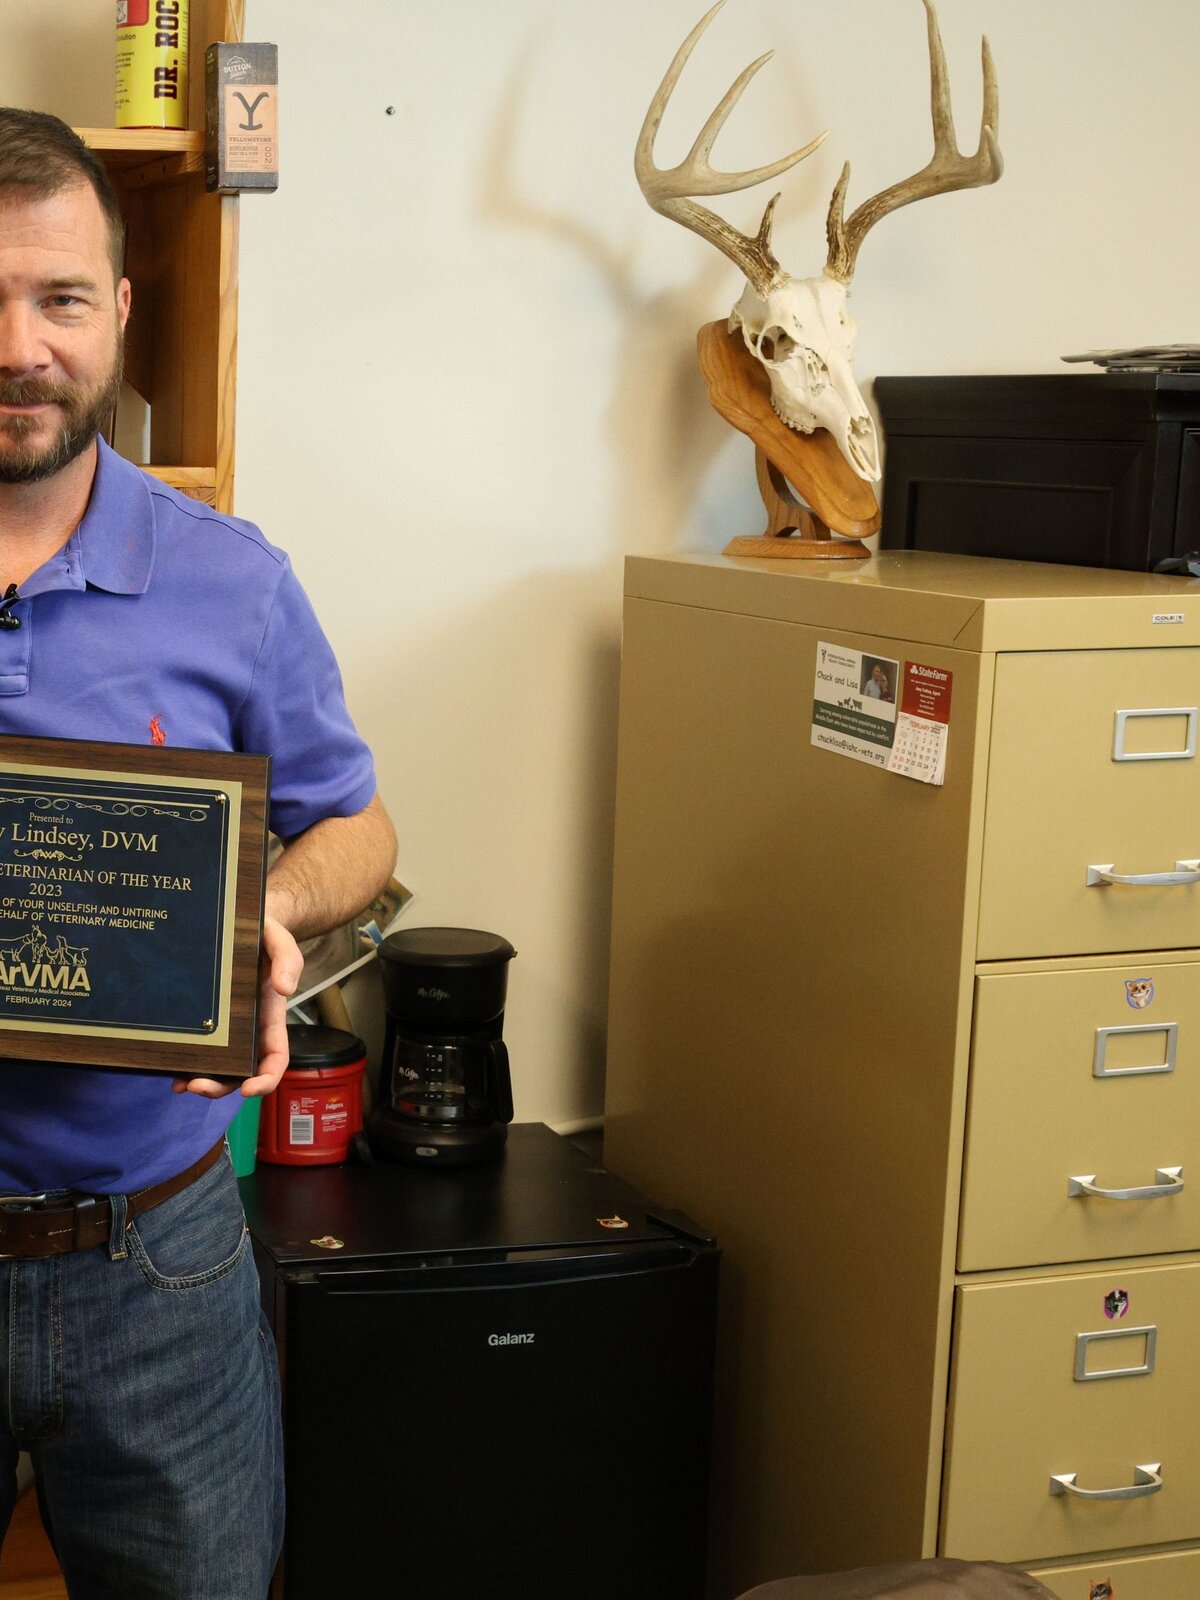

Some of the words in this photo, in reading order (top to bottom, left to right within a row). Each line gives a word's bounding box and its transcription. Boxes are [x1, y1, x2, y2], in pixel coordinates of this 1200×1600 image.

[154, 59, 178, 99] DR.
[817, 670, 833, 682] Chuck
[834, 675, 845, 686] and
[846, 679, 858, 689] Lisa
[910, 720, 930, 731] FEBRUARY
[29, 812, 64, 824] Presented
[11, 822, 94, 851] Lindsey,
[101, 830, 159, 853] DVM
[97, 871, 117, 885] OF
[120, 872, 149, 888] THE
[152, 875, 192, 891] YEAR
[29, 882, 62, 897] 2023
[2, 897, 16, 907] OF
[18, 898, 45, 910] YOUR
[47, 901, 97, 913] UNSELFISH
[100, 906, 120, 915] AND
[122, 908, 168, 919] UNTIRING
[31, 912, 45, 921] OF
[47, 913, 107, 926] VETERINARY
[109, 918, 155, 930] MEDICINE
[12, 986, 38, 994] Veterinary
[5, 995, 51, 1006] FEBRUARY
[52, 999, 72, 1007] 2024
[488, 1333, 535, 1346] Galanz
